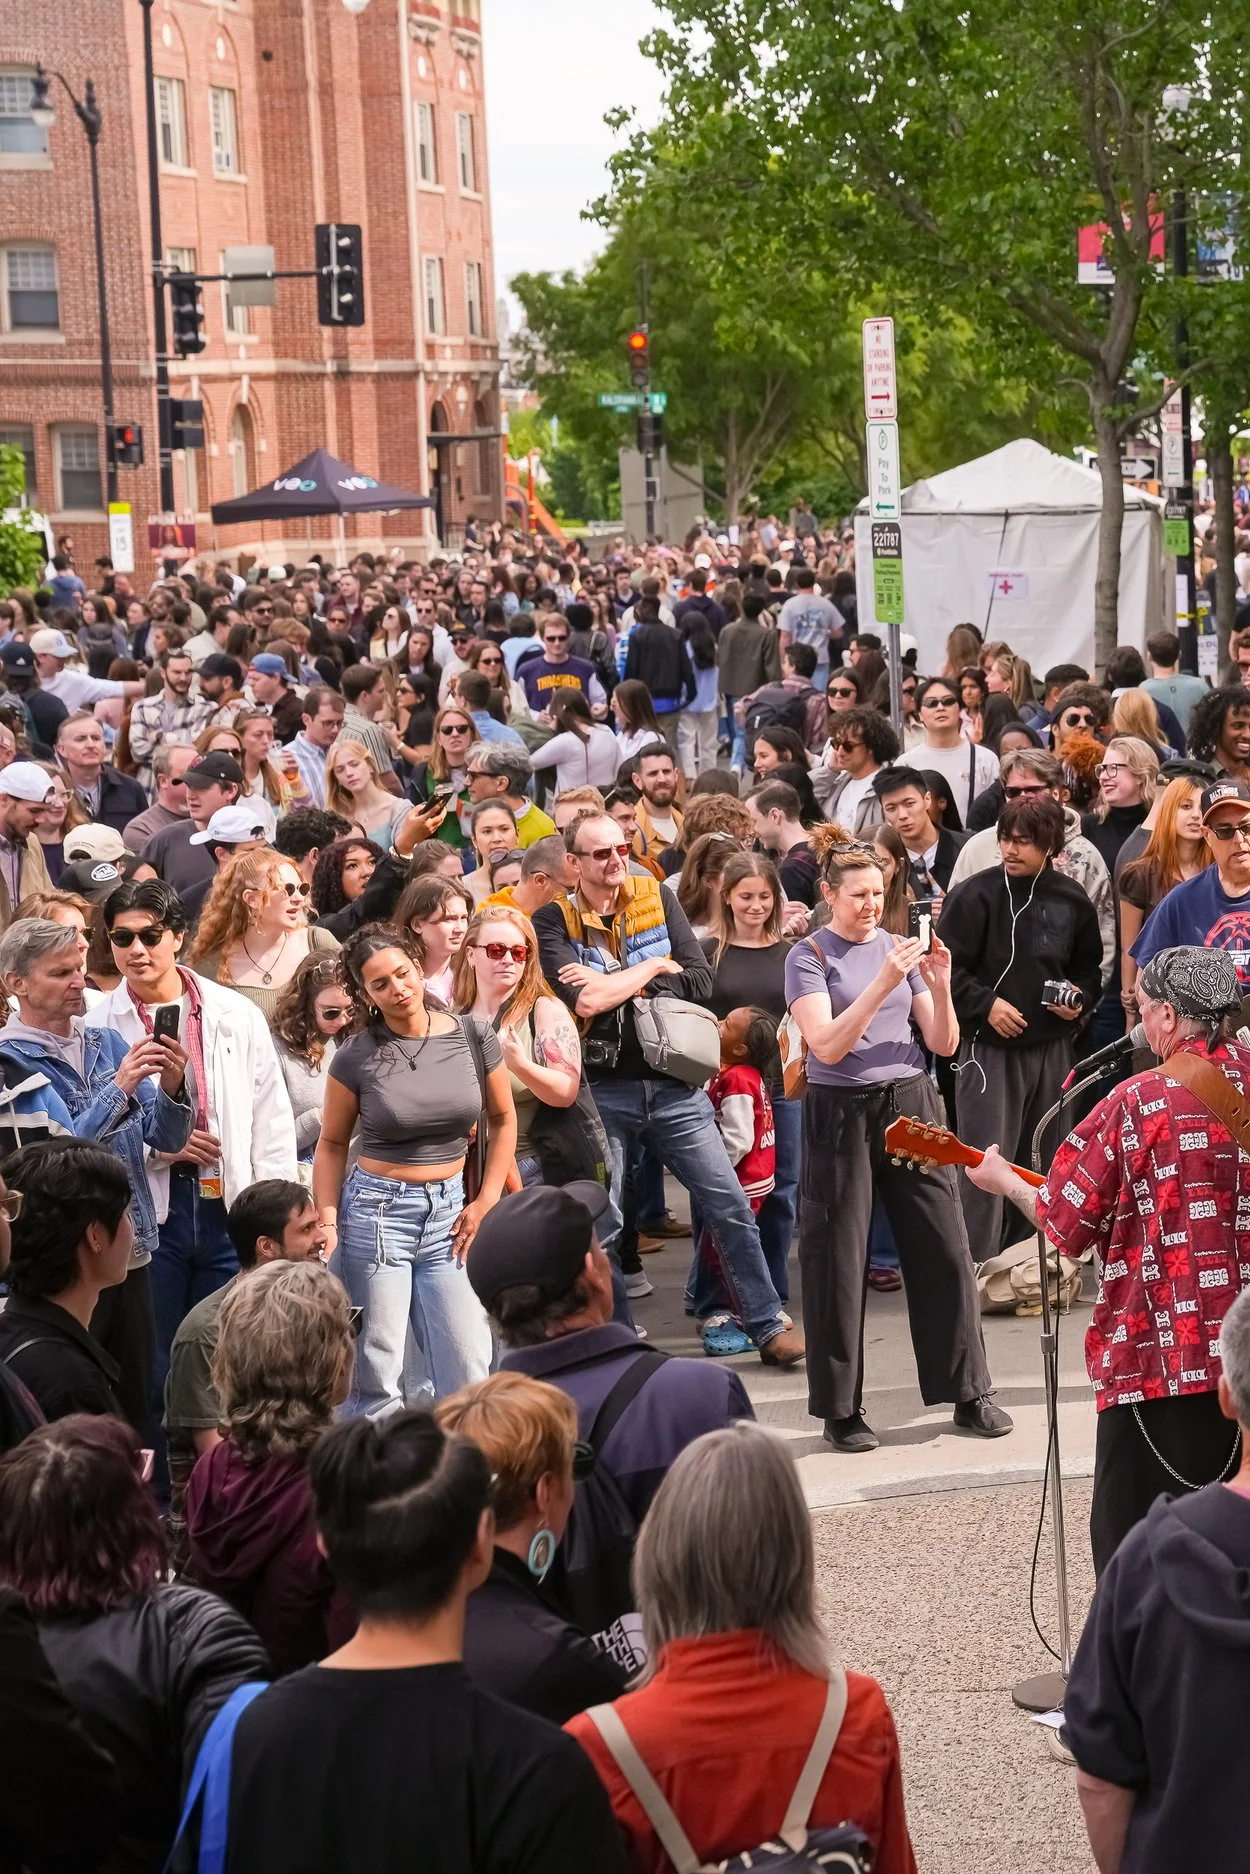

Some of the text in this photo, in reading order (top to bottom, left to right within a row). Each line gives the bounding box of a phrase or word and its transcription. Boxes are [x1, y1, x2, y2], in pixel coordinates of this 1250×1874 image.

[878, 458, 889, 470] Pay
[881, 473, 889, 482] To
[878, 485, 891, 495] Park
[873, 532, 899, 547] 221787
[1209, 785, 1239, 804] BALTIMORE
